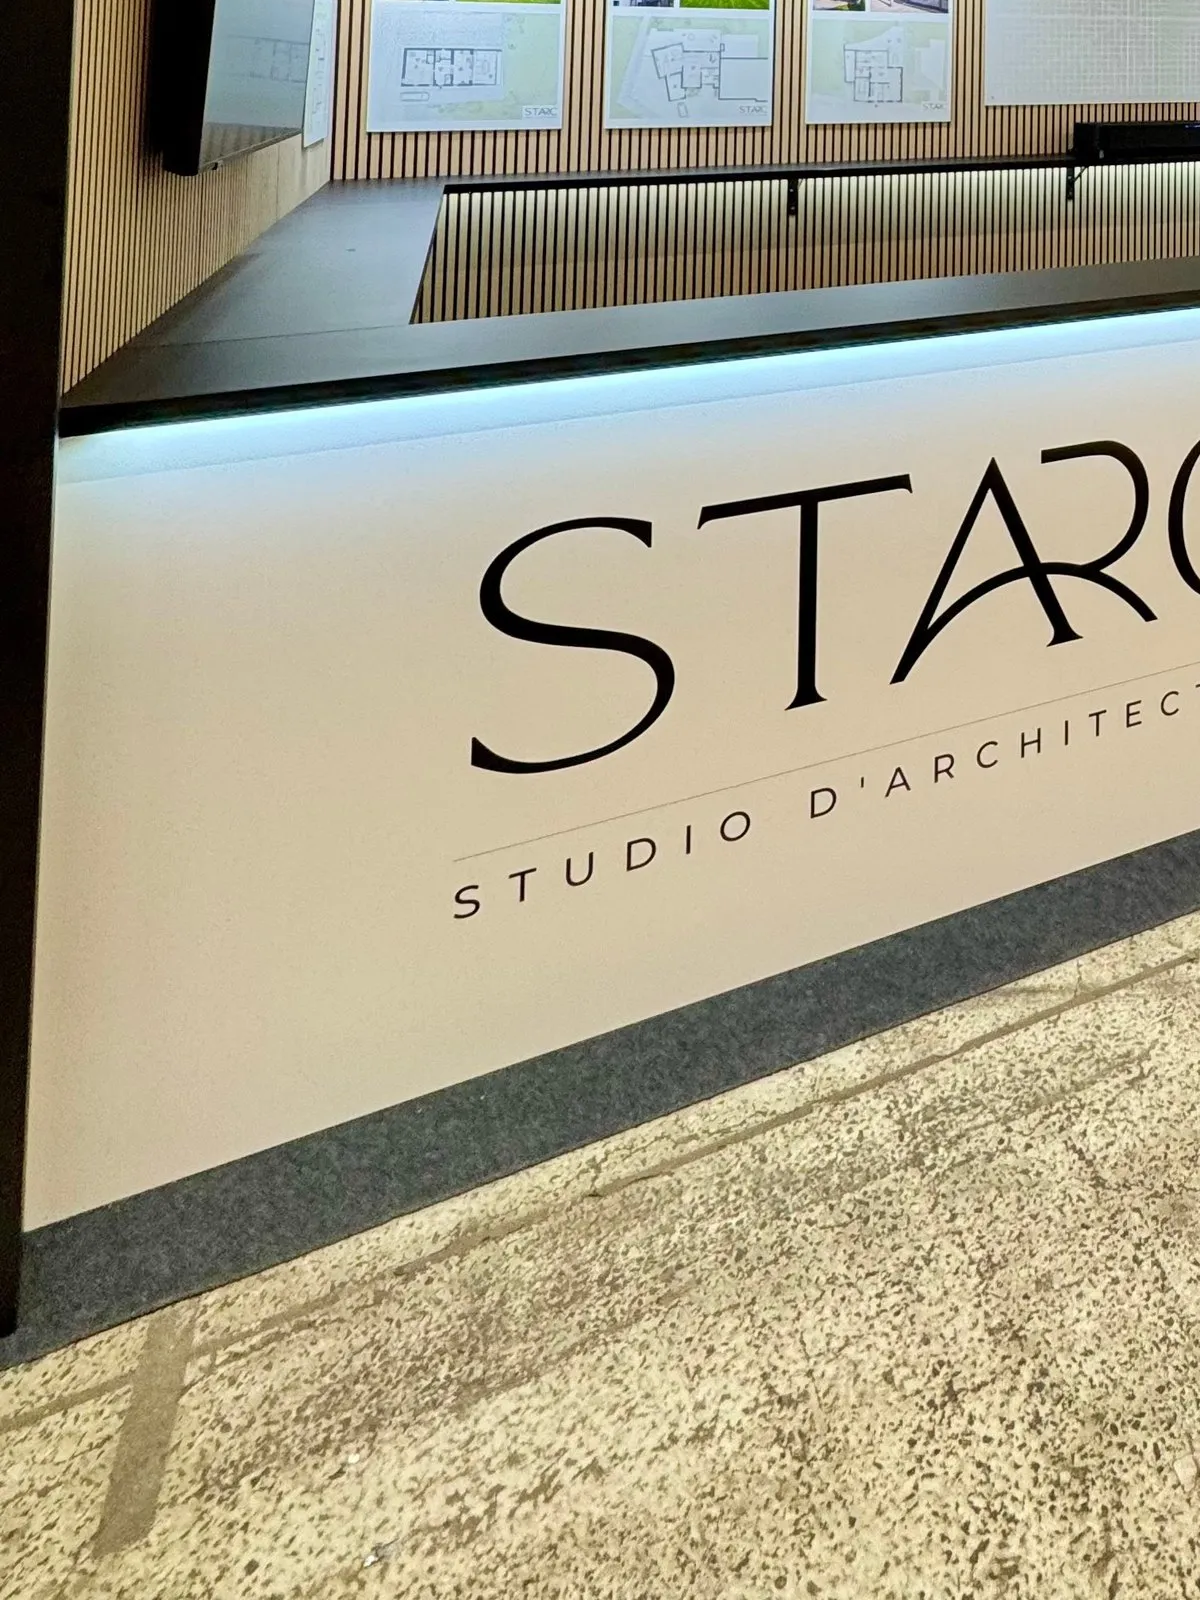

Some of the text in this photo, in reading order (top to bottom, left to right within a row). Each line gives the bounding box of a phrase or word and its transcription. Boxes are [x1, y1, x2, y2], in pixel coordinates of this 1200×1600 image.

[524, 107, 557, 116] STARC
[739, 105, 768, 113] STARC
[453, 811, 751, 919] STUDIO
